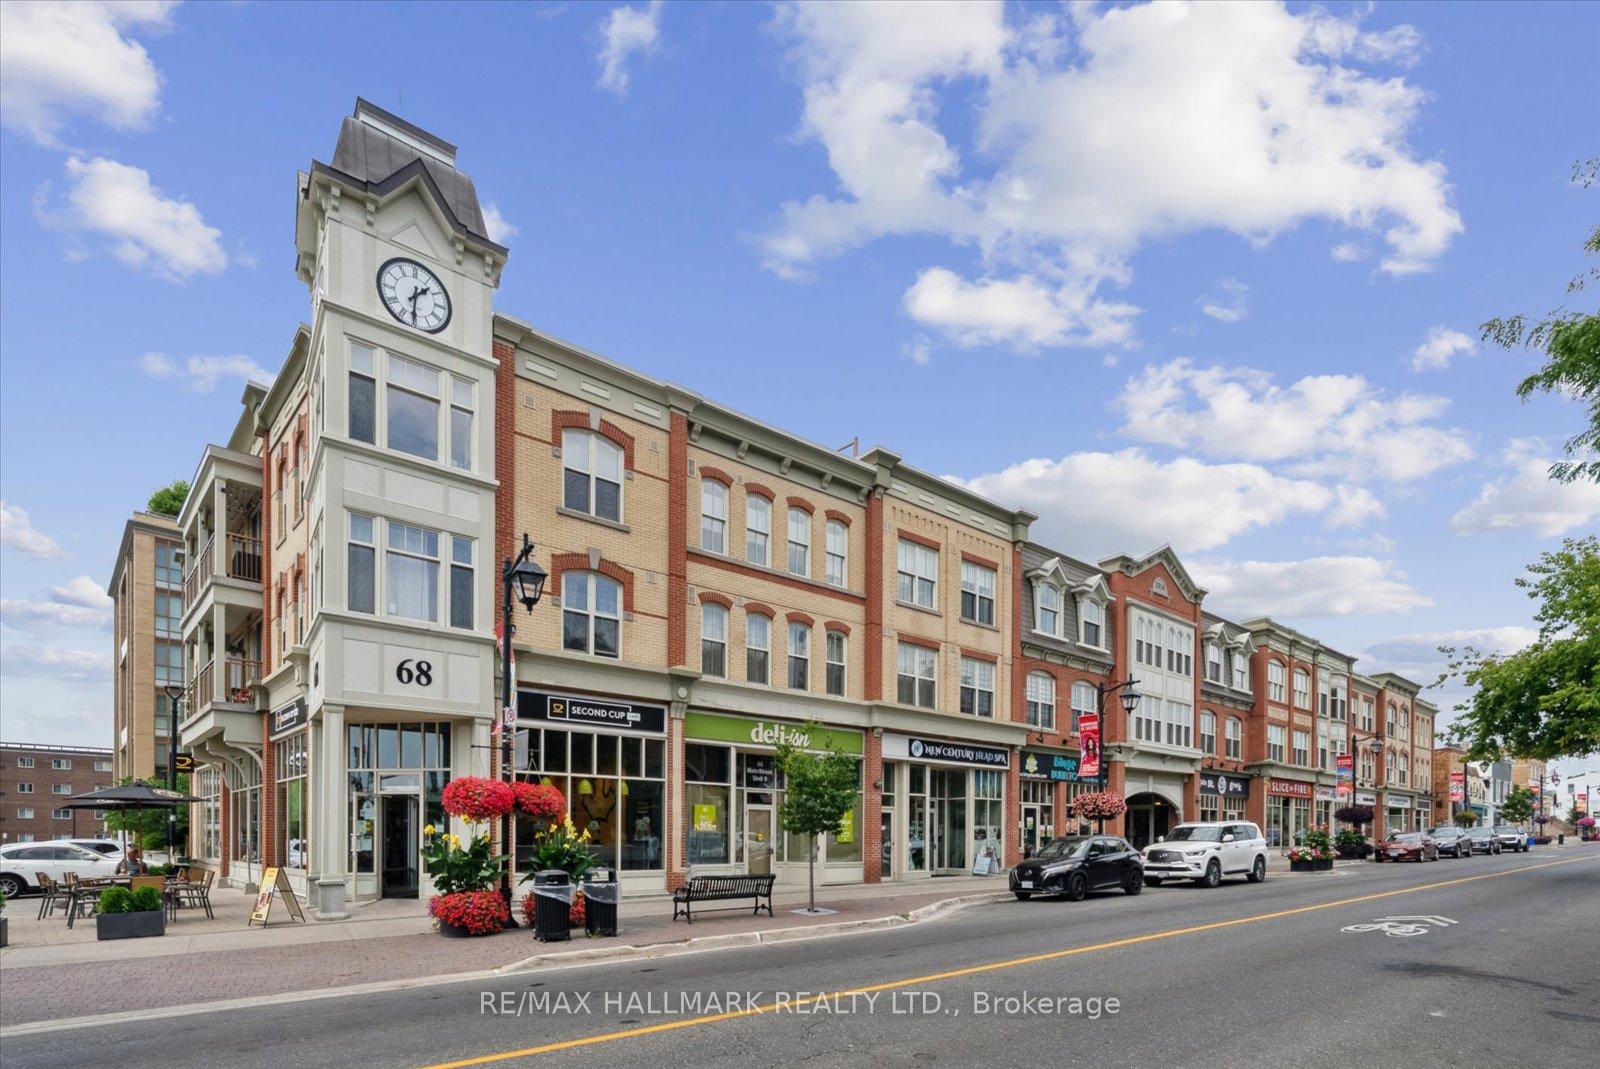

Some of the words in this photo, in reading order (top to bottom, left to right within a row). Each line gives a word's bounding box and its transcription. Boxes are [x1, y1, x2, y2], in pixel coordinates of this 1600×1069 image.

[396, 659, 432, 686] 68
[571, 706, 607, 717] SECOND
[608, 710, 625, 719] CUP
[924, 744, 942, 756] NEW
[942, 747, 974, 760] CENTURY
[975, 751, 993, 762] HEAD
[994, 753, 1007, 764] SPA
[1272, 782, 1289, 791] SLICE
[1294, 784, 1307, 794] FIRE
